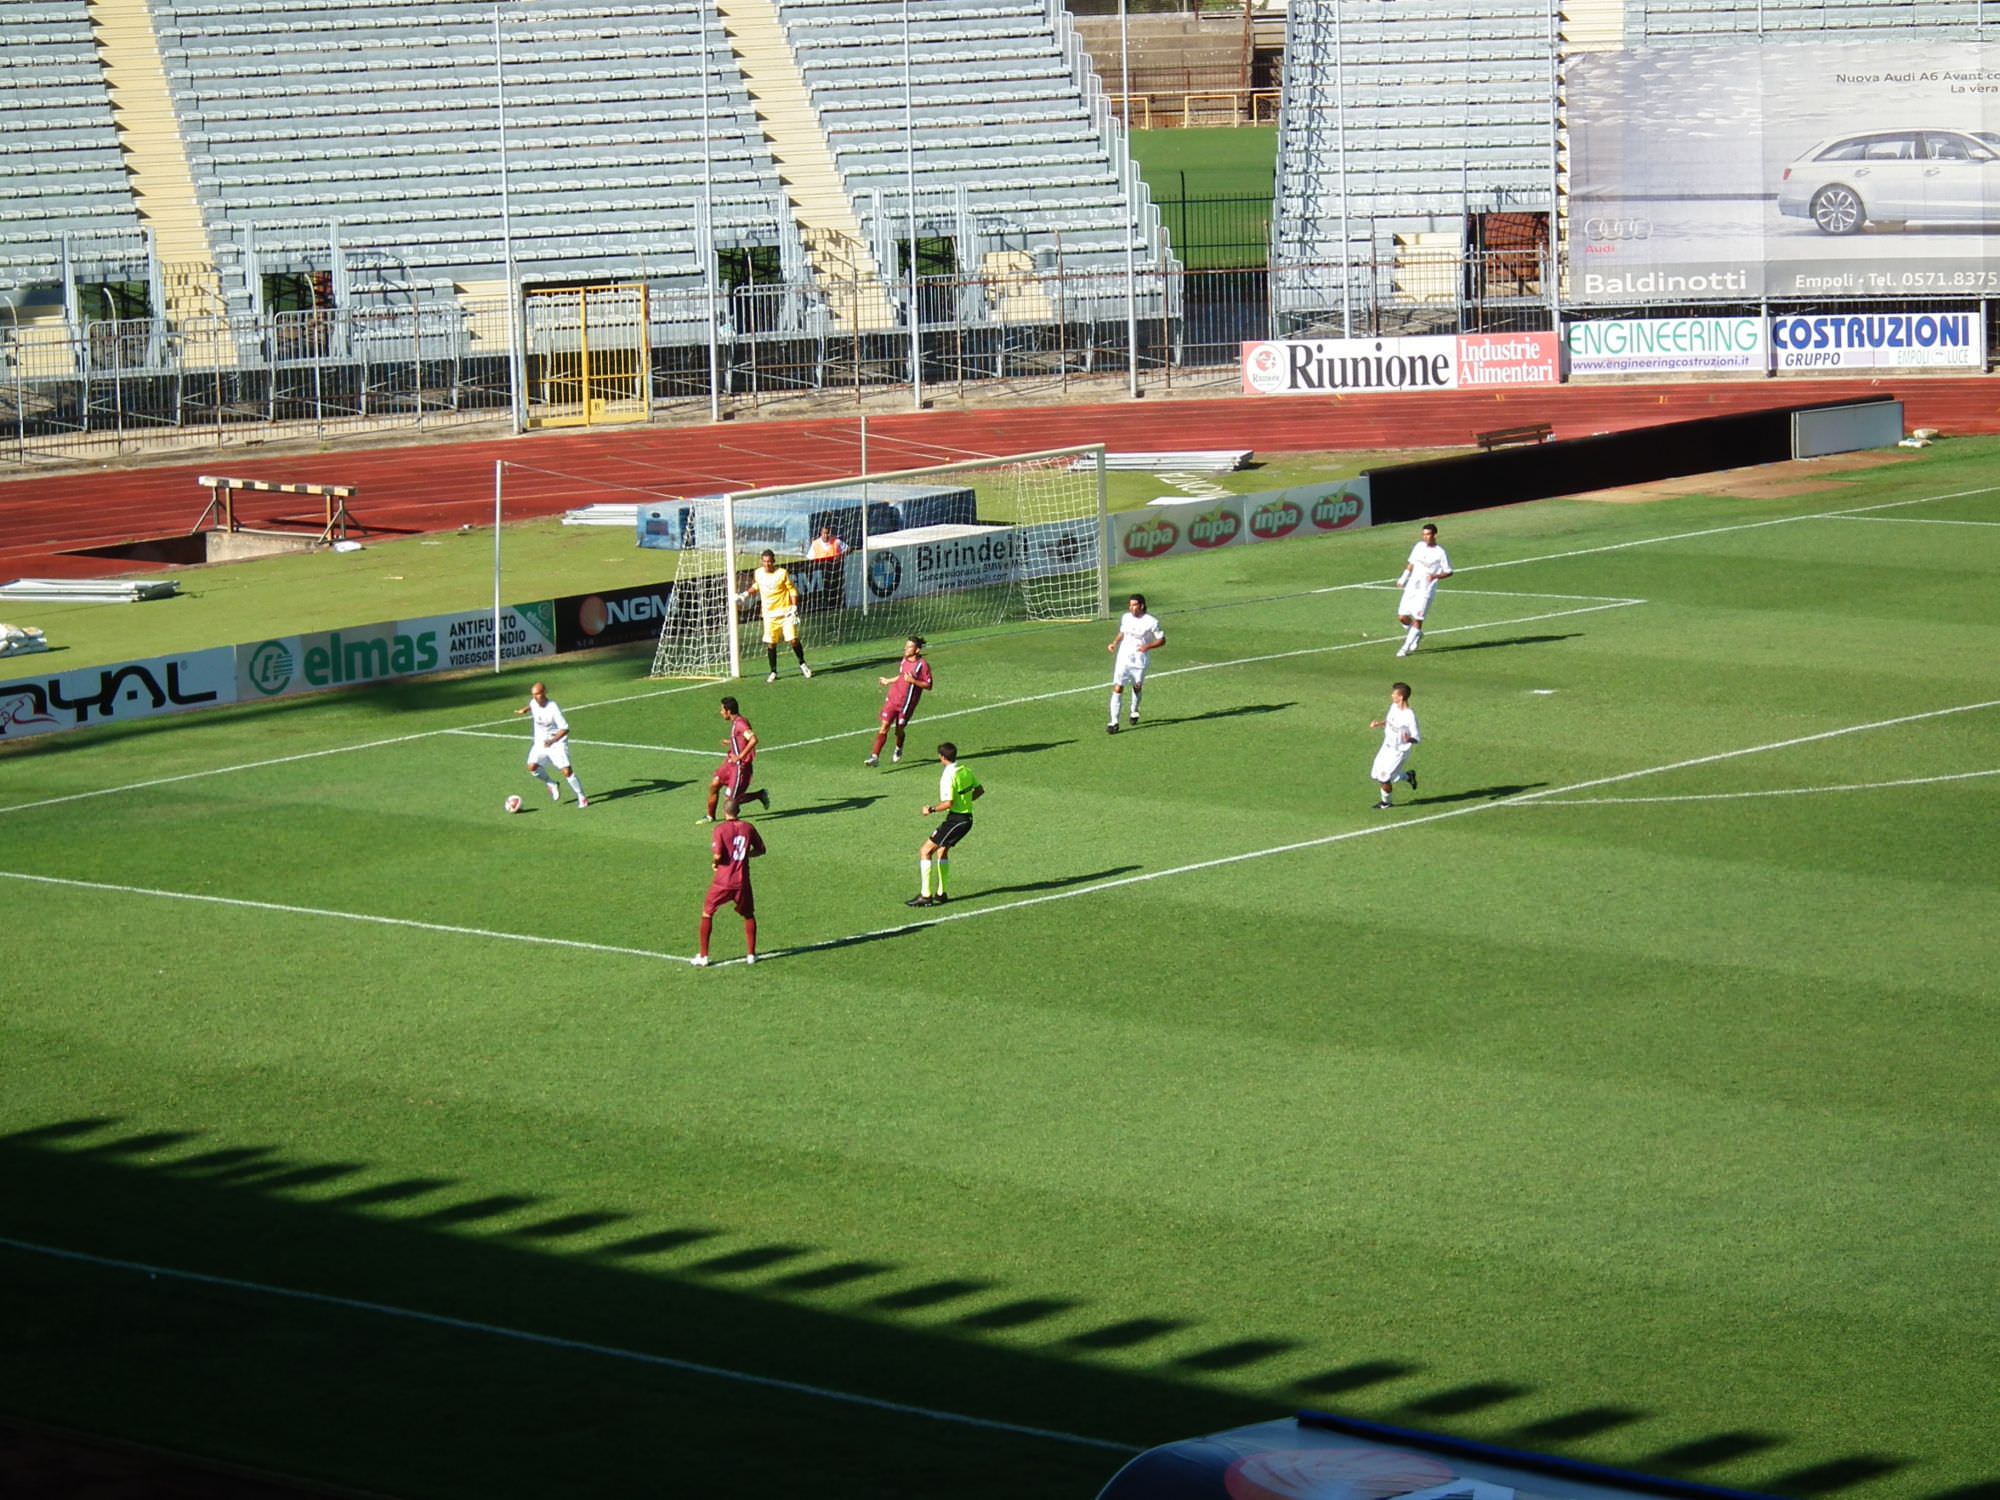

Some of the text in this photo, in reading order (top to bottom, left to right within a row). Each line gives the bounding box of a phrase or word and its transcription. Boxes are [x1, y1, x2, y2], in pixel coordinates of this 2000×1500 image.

[1836, 73, 1880, 83] Nuova
[1884, 72, 1915, 82] Audi
[1920, 71, 1938, 81] A6
[1943, 71, 1984, 81] Avant
[1951, 84, 1998, 93] La vera
[1585, 245, 1615, 254] Audi
[1585, 270, 1746, 294] Baldinotti
[1795, 273, 1853, 290] Empoli
[1868, 272, 1897, 286] Tel.
[1902, 271, 1998, 287] 0571.8375
[1568, 320, 1757, 355] ENGINEERING
[1773, 315, 1969, 349] COSTRUZIONI
[1460, 336, 1540, 362] Industrie
[1785, 352, 1841, 367] GRUPPO
[1286, 342, 1450, 390] Riunione
[1459, 358, 1553, 385] Alimentari
[1573, 356, 1750, 371] www.engineeringcostruzioni.it
[449, 615, 516, 637] ANTIFUTO
[450, 630, 526, 652] ANTINCNDIO
[304, 631, 438, 686] elmas
[449, 643, 543, 666] VIDEOSOREGLIANZA
[733, 835, 746, 861] 3
